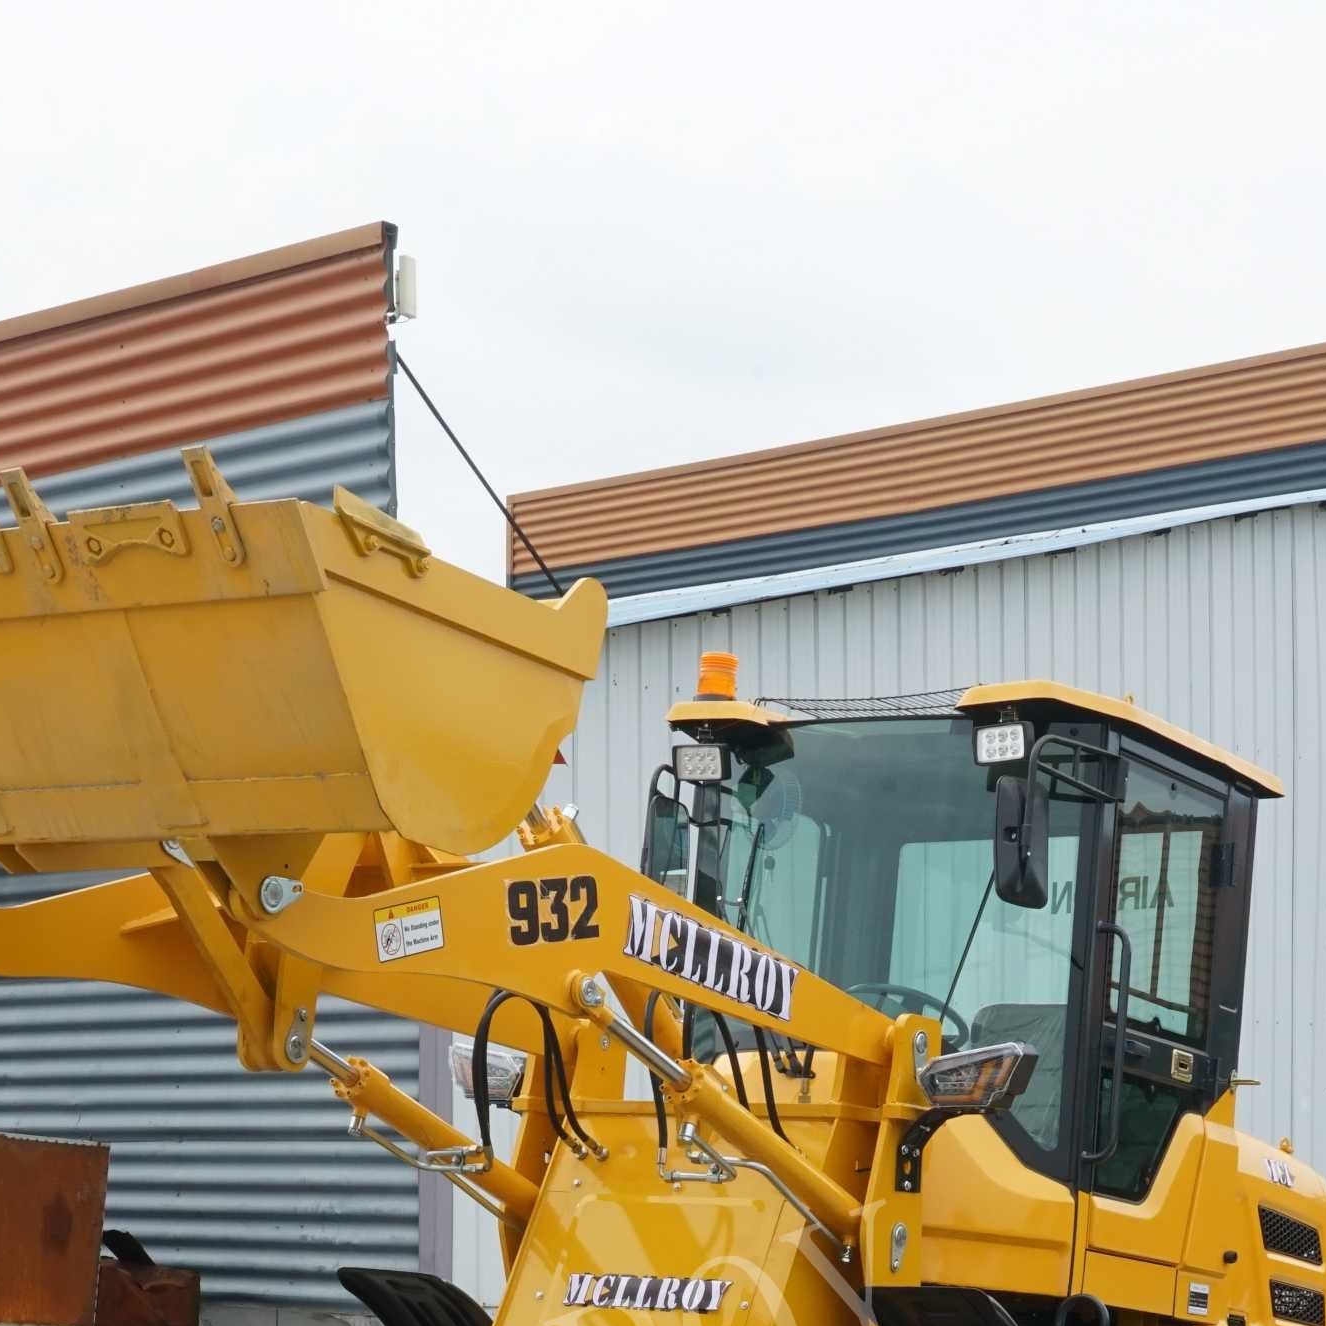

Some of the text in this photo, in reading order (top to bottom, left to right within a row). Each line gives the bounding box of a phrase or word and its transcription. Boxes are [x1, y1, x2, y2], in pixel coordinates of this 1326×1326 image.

[405, 902, 429, 913] DANGER
[507, 875, 600, 946] 932
[623, 894, 799, 1022] MCLLROY
[562, 1272, 734, 1313] MCLLROY
